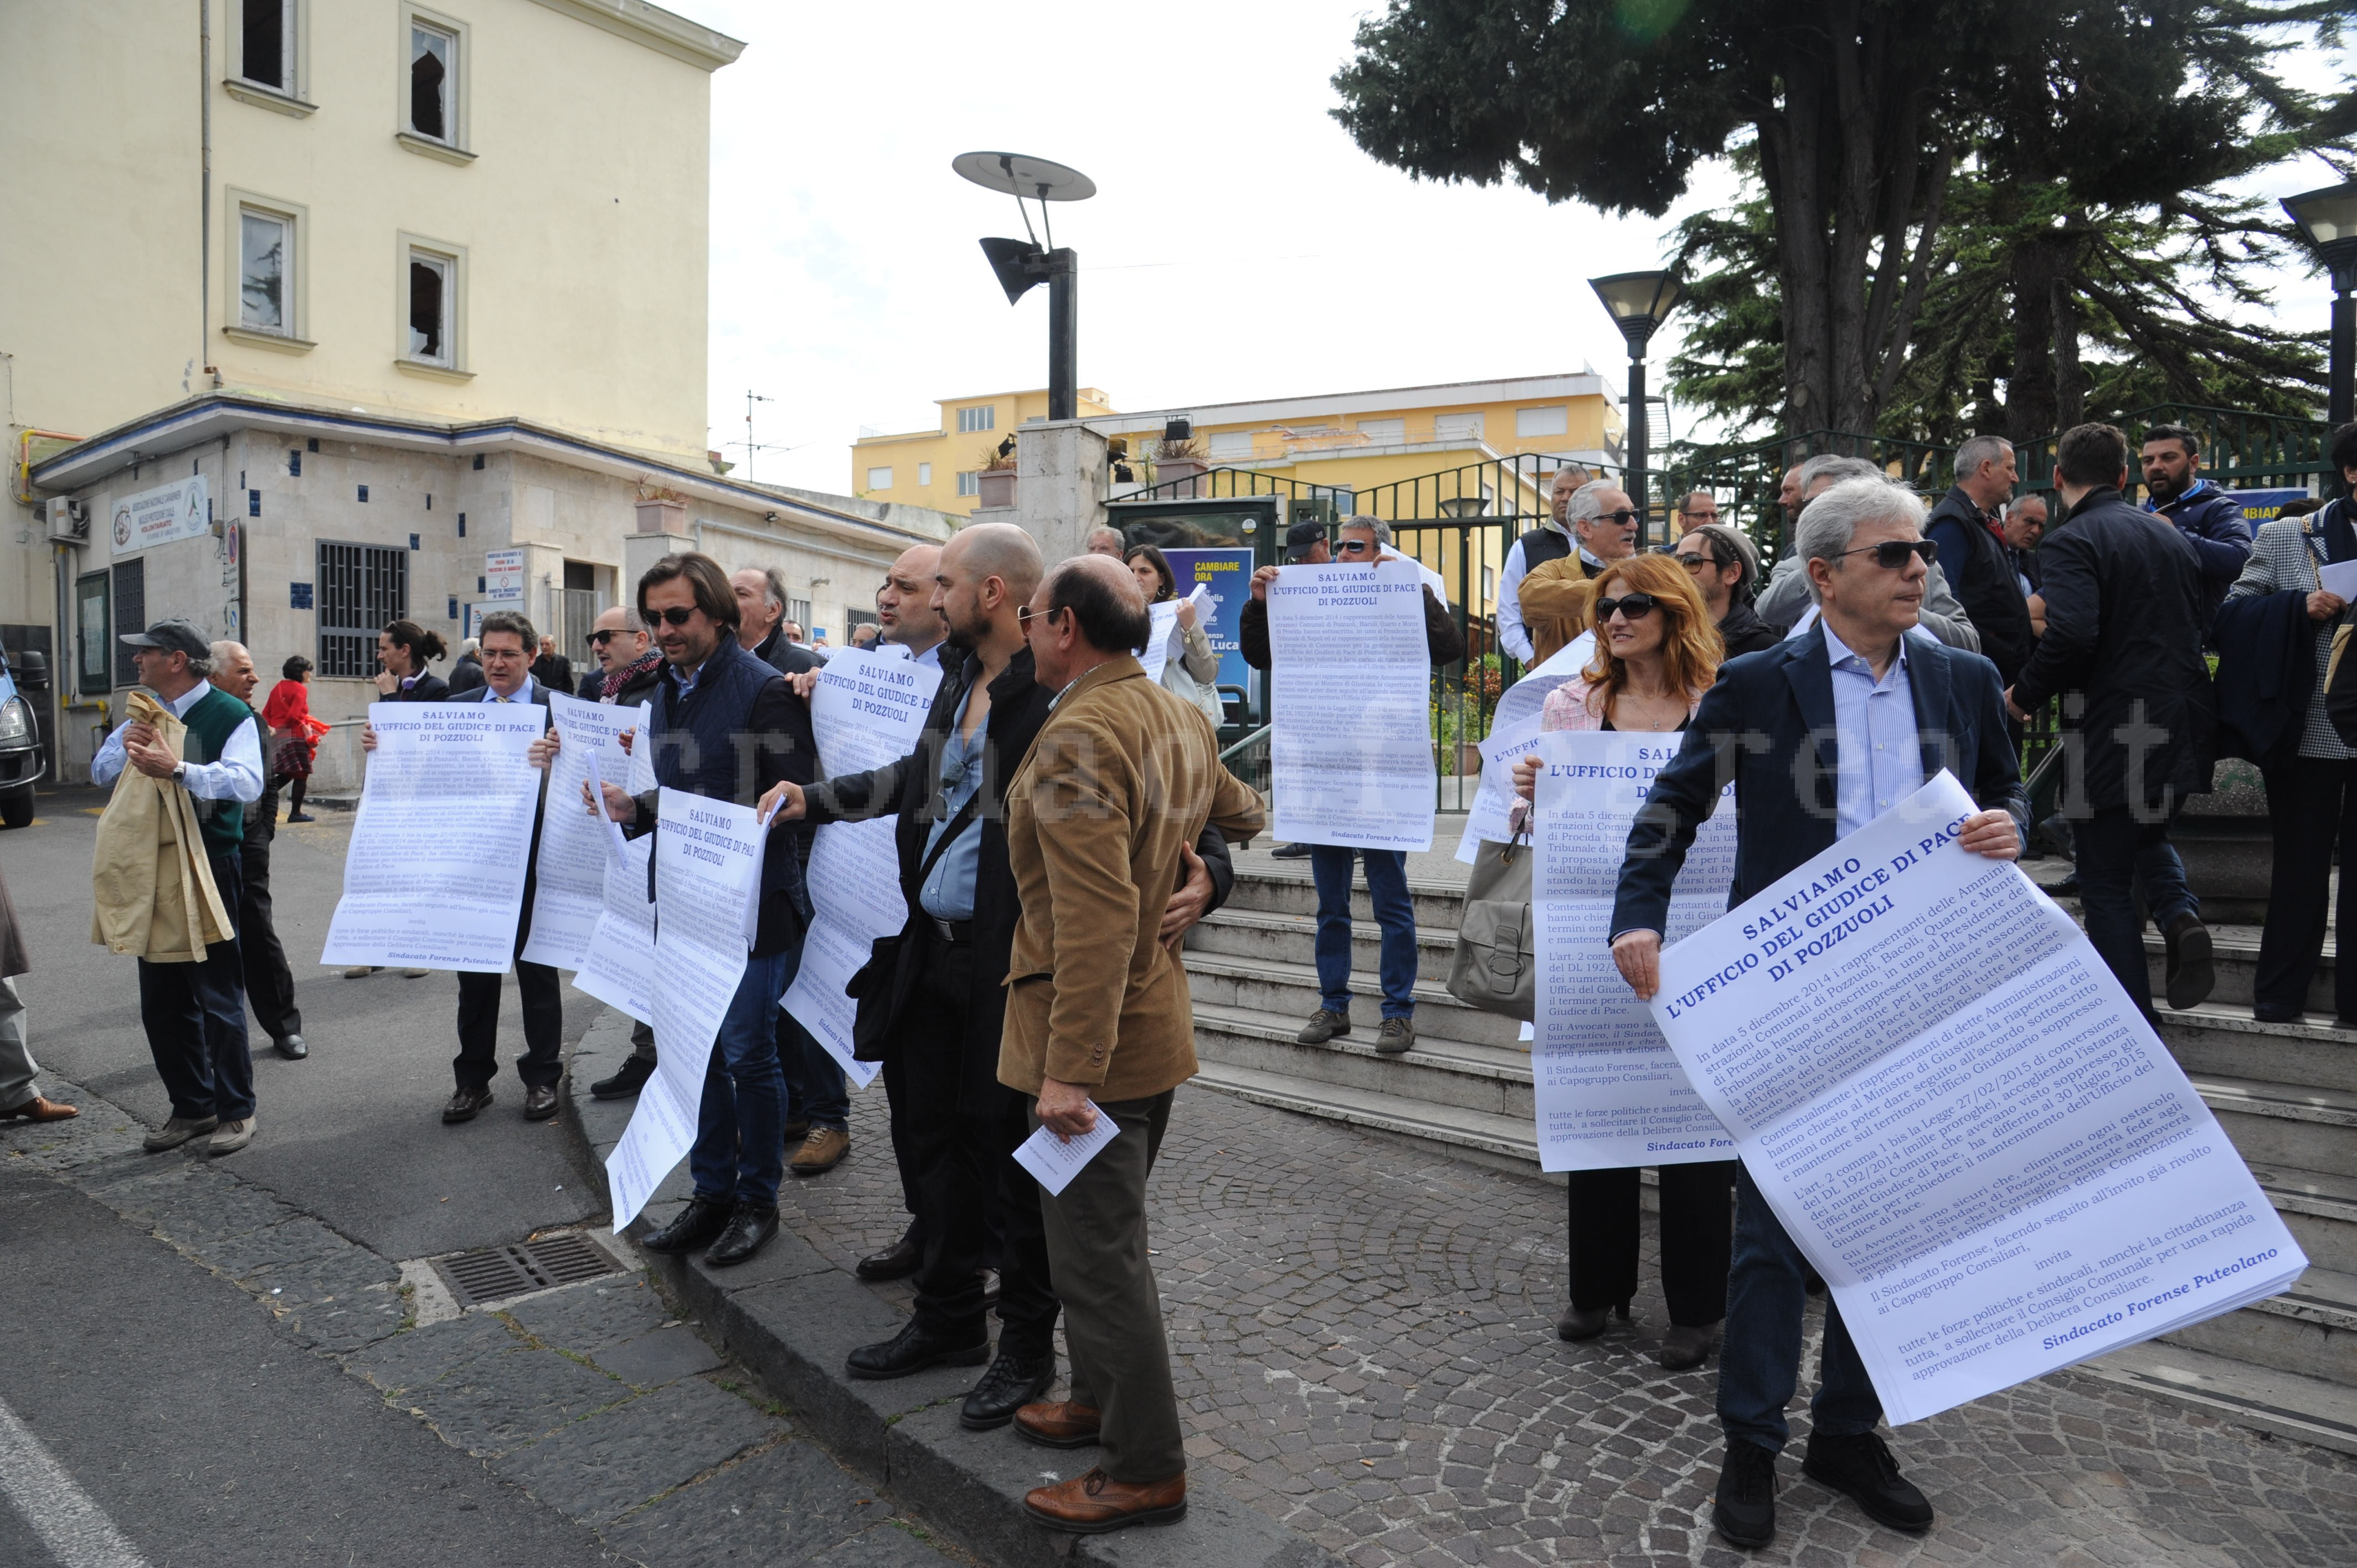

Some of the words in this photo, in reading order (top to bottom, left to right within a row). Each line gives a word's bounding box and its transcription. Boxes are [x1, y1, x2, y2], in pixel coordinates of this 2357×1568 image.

[141, 519, 172, 534] VOLONTARIATO
[1195, 562, 1240, 571] CAMBIARE
[1195, 572, 1213, 581] ORA
[1318, 572, 1376, 582] SALVIAMO
[1273, 586, 1318, 595] L'UFFICIO
[1321, 586, 1340, 594] DEL
[1342, 585, 1381, 594] GIUDICE
[1383, 584, 1392, 592] DI
[1394, 584, 1417, 592] PACE
[1318, 598, 1328, 606] DI
[1331, 597, 1377, 606] POZZUOLI
[1212, 640, 1239, 651] Luca
[859, 664, 914, 687] SALVIAMO
[817, 670, 856, 691] L'UFFICIO
[857, 682, 875, 696] DEL
[877, 687, 918, 706] GIUDICE
[423, 711, 485, 720] SALVIAMO
[567, 707, 604, 722] SALVIAMO
[852, 698, 862, 710] DI
[864, 701, 908, 723] POZZUOLI
[375, 723, 421, 731] L'UFFICIO
[447, 723, 491, 731] GIUDICE
[495, 724, 506, 732] DI
[509, 724, 536, 733] PACE
[579, 722, 610, 735] GIUDICE
[434, 734, 483, 742] POZZUOLI
[573, 733, 605, 746] POZZUOLI
[1550, 765, 1637, 778] L'UFFICIO
[689, 809, 732, 830] SALVIAMO
[688, 827, 702, 840] DEL
[704, 831, 732, 849] GIUDICE
[733, 839, 742, 853] DI
[1331, 831, 1364, 839] Sindacato
[1366, 833, 1391, 842] Forense
[1392, 835, 1425, 844] Puteolano
[683, 843, 692, 855] DI
[692, 846, 724, 866] POZZUOLI
[1743, 858, 1860, 941] SALVIAMO
[1665, 953, 1759, 1019] L'UFFICIO
[1760, 926, 1804, 958] DEL
[1805, 868, 1890, 928] GIUDICE
[1890, 849, 1919, 874] DI
[1767, 958, 1794, 982] DI
[1793, 894, 1895, 966] POZZUOLI
[388, 952, 427, 960] Sindacato
[429, 954, 460, 962] Forense
[462, 957, 503, 966] Puteolano
[1696, 1053, 1711, 1064] In
[1712, 1036, 1738, 1054] data
[1737, 1027, 1747, 1037] 5
[1749, 996, 1800, 1031] dicembre
[1801, 973, 1831, 998] 2014
[1832, 968, 1840, 977] i
[1840, 913, 1927, 973] rappresentanti
[1928, 896, 1956, 917] delle
[1958, 857, 2010, 899] Ammini-
[1549, 1007, 1588, 1016] Giudice
[1591, 1006, 1601, 1015] di
[1604, 1006, 1629, 1014] Pace.
[818, 1018, 837, 1041] Sindacato
[837, 1036, 853, 1056] Forense
[1761, 1091, 1851, 1146] Contestualmente
[1851, 1085, 1858, 1094] i
[1858, 1037, 1941, 1090] rappresentanti
[1941, 1029, 1954, 1043] di
[1954, 1014, 1984, 1035] dette
[1985, 956, 2082, 1018] Amministrazioni
[1547, 1077, 1557, 1086] ai
[1560, 1076, 1620, 1087] Capogruppo
[1623, 1071, 1672, 1082] Consiliari,
[1549, 1111, 1572, 1120] tutte
[1575, 1110, 1583, 1118] le
[1586, 1108, 1608, 1117] forze
[1611, 1106, 1651, 1118] politiche
[1661, 1102, 1708, 1113] sindacali,
[1793, 1181, 1824, 1200] L'art.
[1825, 1173, 1835, 1183] 2
[1836, 1151, 1879, 1177] comma
[1879, 1143, 1887, 1152] 1
[1887, 1133, 1908, 1147] bis
[1907, 1126, 1922, 1137] la
[1921, 1106, 1956, 1129] Legge
[1956, 1061, 2031, 1110] 27/02/2015
[2034, 1053, 2047, 1066] di
[2048, 1014, 2120, 1058] conversione
[1647, 1139, 1705, 1152] Sindacato
[1710, 1139, 1733, 1149] Fore
[2034, 1250, 2072, 1271] invita
[1898, 1337, 1927, 1354] tutte
[1927, 1332, 1940, 1341] le
[1941, 1318, 1971, 1335] forze
[1973, 1296, 2025, 1325] politiche
[2036, 1263, 2098, 1294] sindacali,
[2098, 1241, 2147, 1268] nonché
[2147, 1237, 2163, 1247] la
[2164, 1201, 2248, 1240] cittadinanza
[2043, 1312, 2123, 1350] Sindacato
[2126, 1284, 2190, 1316] Forense
[2193, 1249, 2278, 1289] Puteolano
